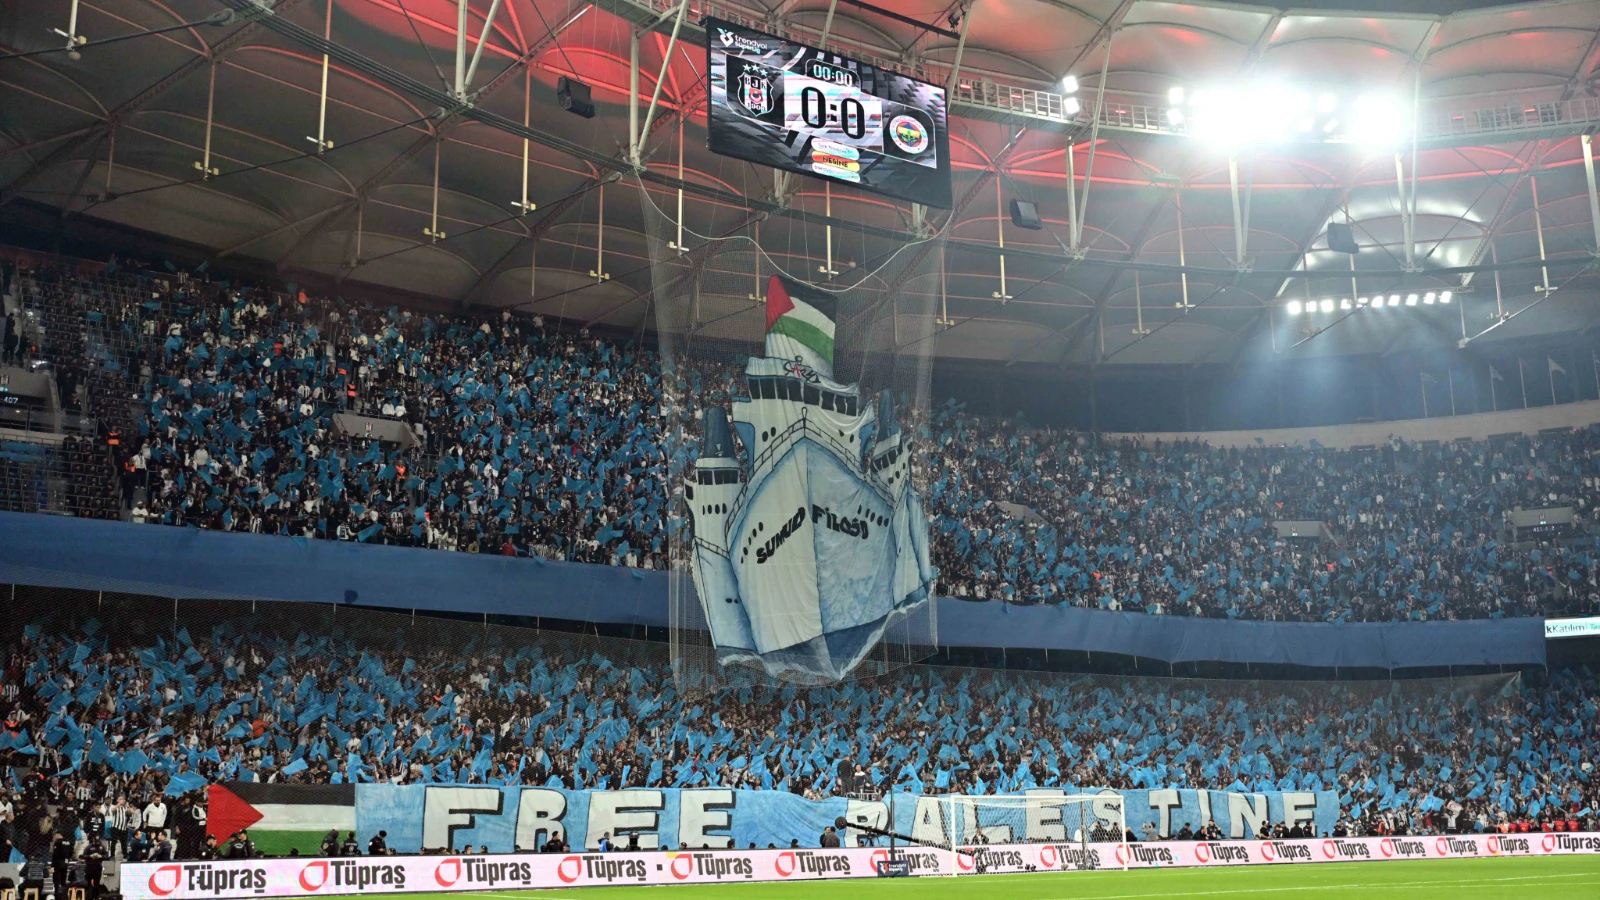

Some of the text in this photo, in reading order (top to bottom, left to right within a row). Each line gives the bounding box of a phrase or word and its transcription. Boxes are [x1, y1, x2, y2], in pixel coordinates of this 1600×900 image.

[813, 64, 853, 87] 00:00
[801, 86, 865, 139] 0:0
[756, 506, 806, 564] SUMUD
[422, 785, 1318, 850] FREE PALESTINE
[1129, 844, 1173, 865] Tüpraş
[1208, 842, 1249, 862] Tüpraş
[1272, 841, 1311, 861] Tüpraş
[1333, 840, 1371, 859] Tüpraş
[1391, 838, 1426, 857] Tüpraş
[1445, 837, 1478, 855] Tüpraş
[1497, 835, 1530, 853] Tüpraş
[331, 860, 406, 889] Tüpraş
[462, 858, 532, 885] Tüpraş
[582, 855, 647, 881] Tüpraş
[693, 853, 753, 879] Tüpraş
[795, 851, 851, 876] Tüpraş
[184, 864, 267, 894] Tüpraş
